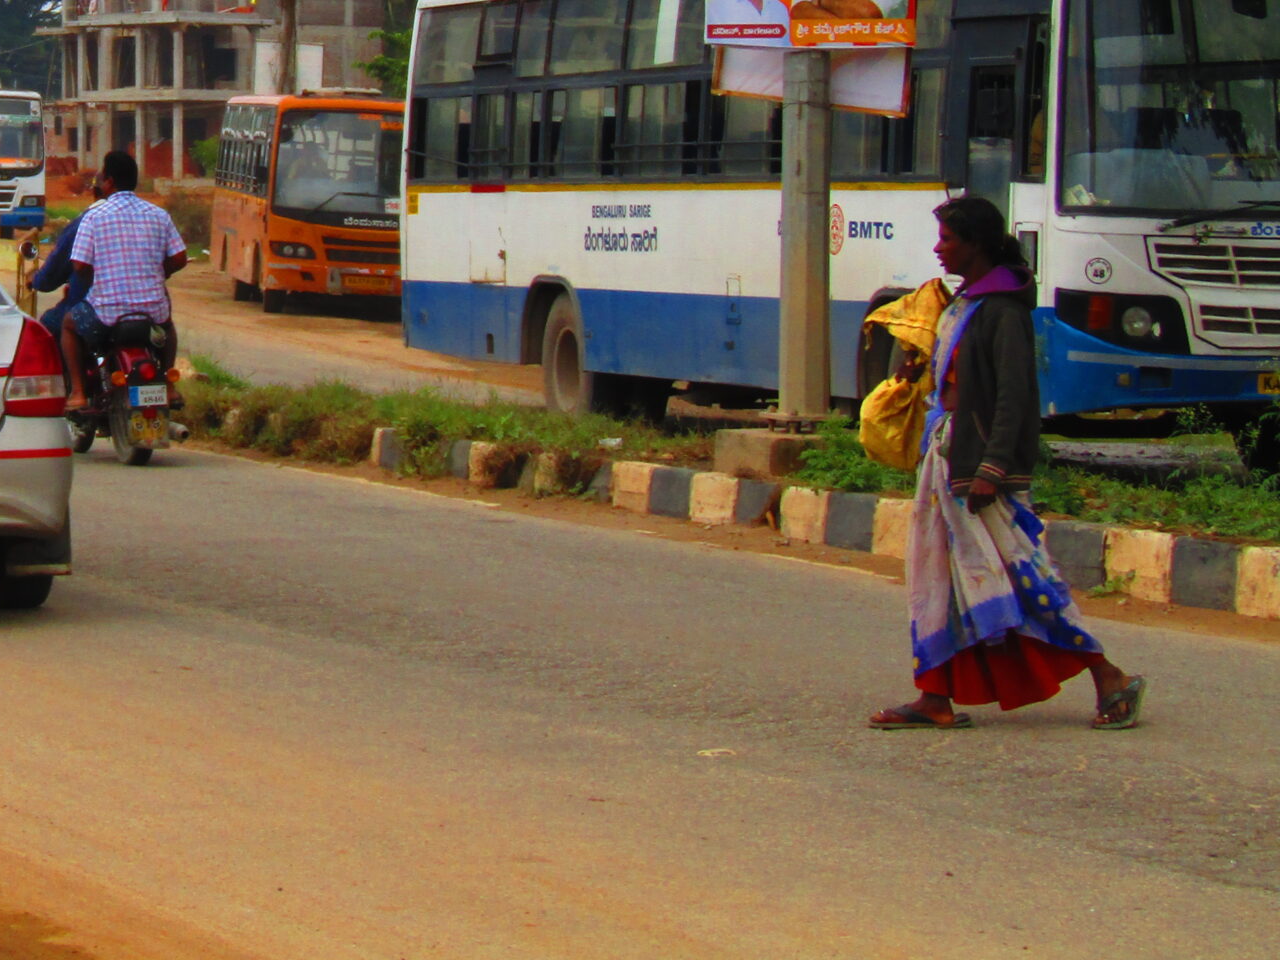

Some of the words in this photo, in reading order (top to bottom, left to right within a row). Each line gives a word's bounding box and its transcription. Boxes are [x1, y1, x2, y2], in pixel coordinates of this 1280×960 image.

[591, 205, 627, 218] BENGALURU
[629, 204, 652, 218] SARIGE
[584, 226, 629, 252] ಬೆಂಗಳೂರು
[630, 226, 658, 252] ಸಾರಿಗೆ
[848, 221, 894, 240] BMTC
